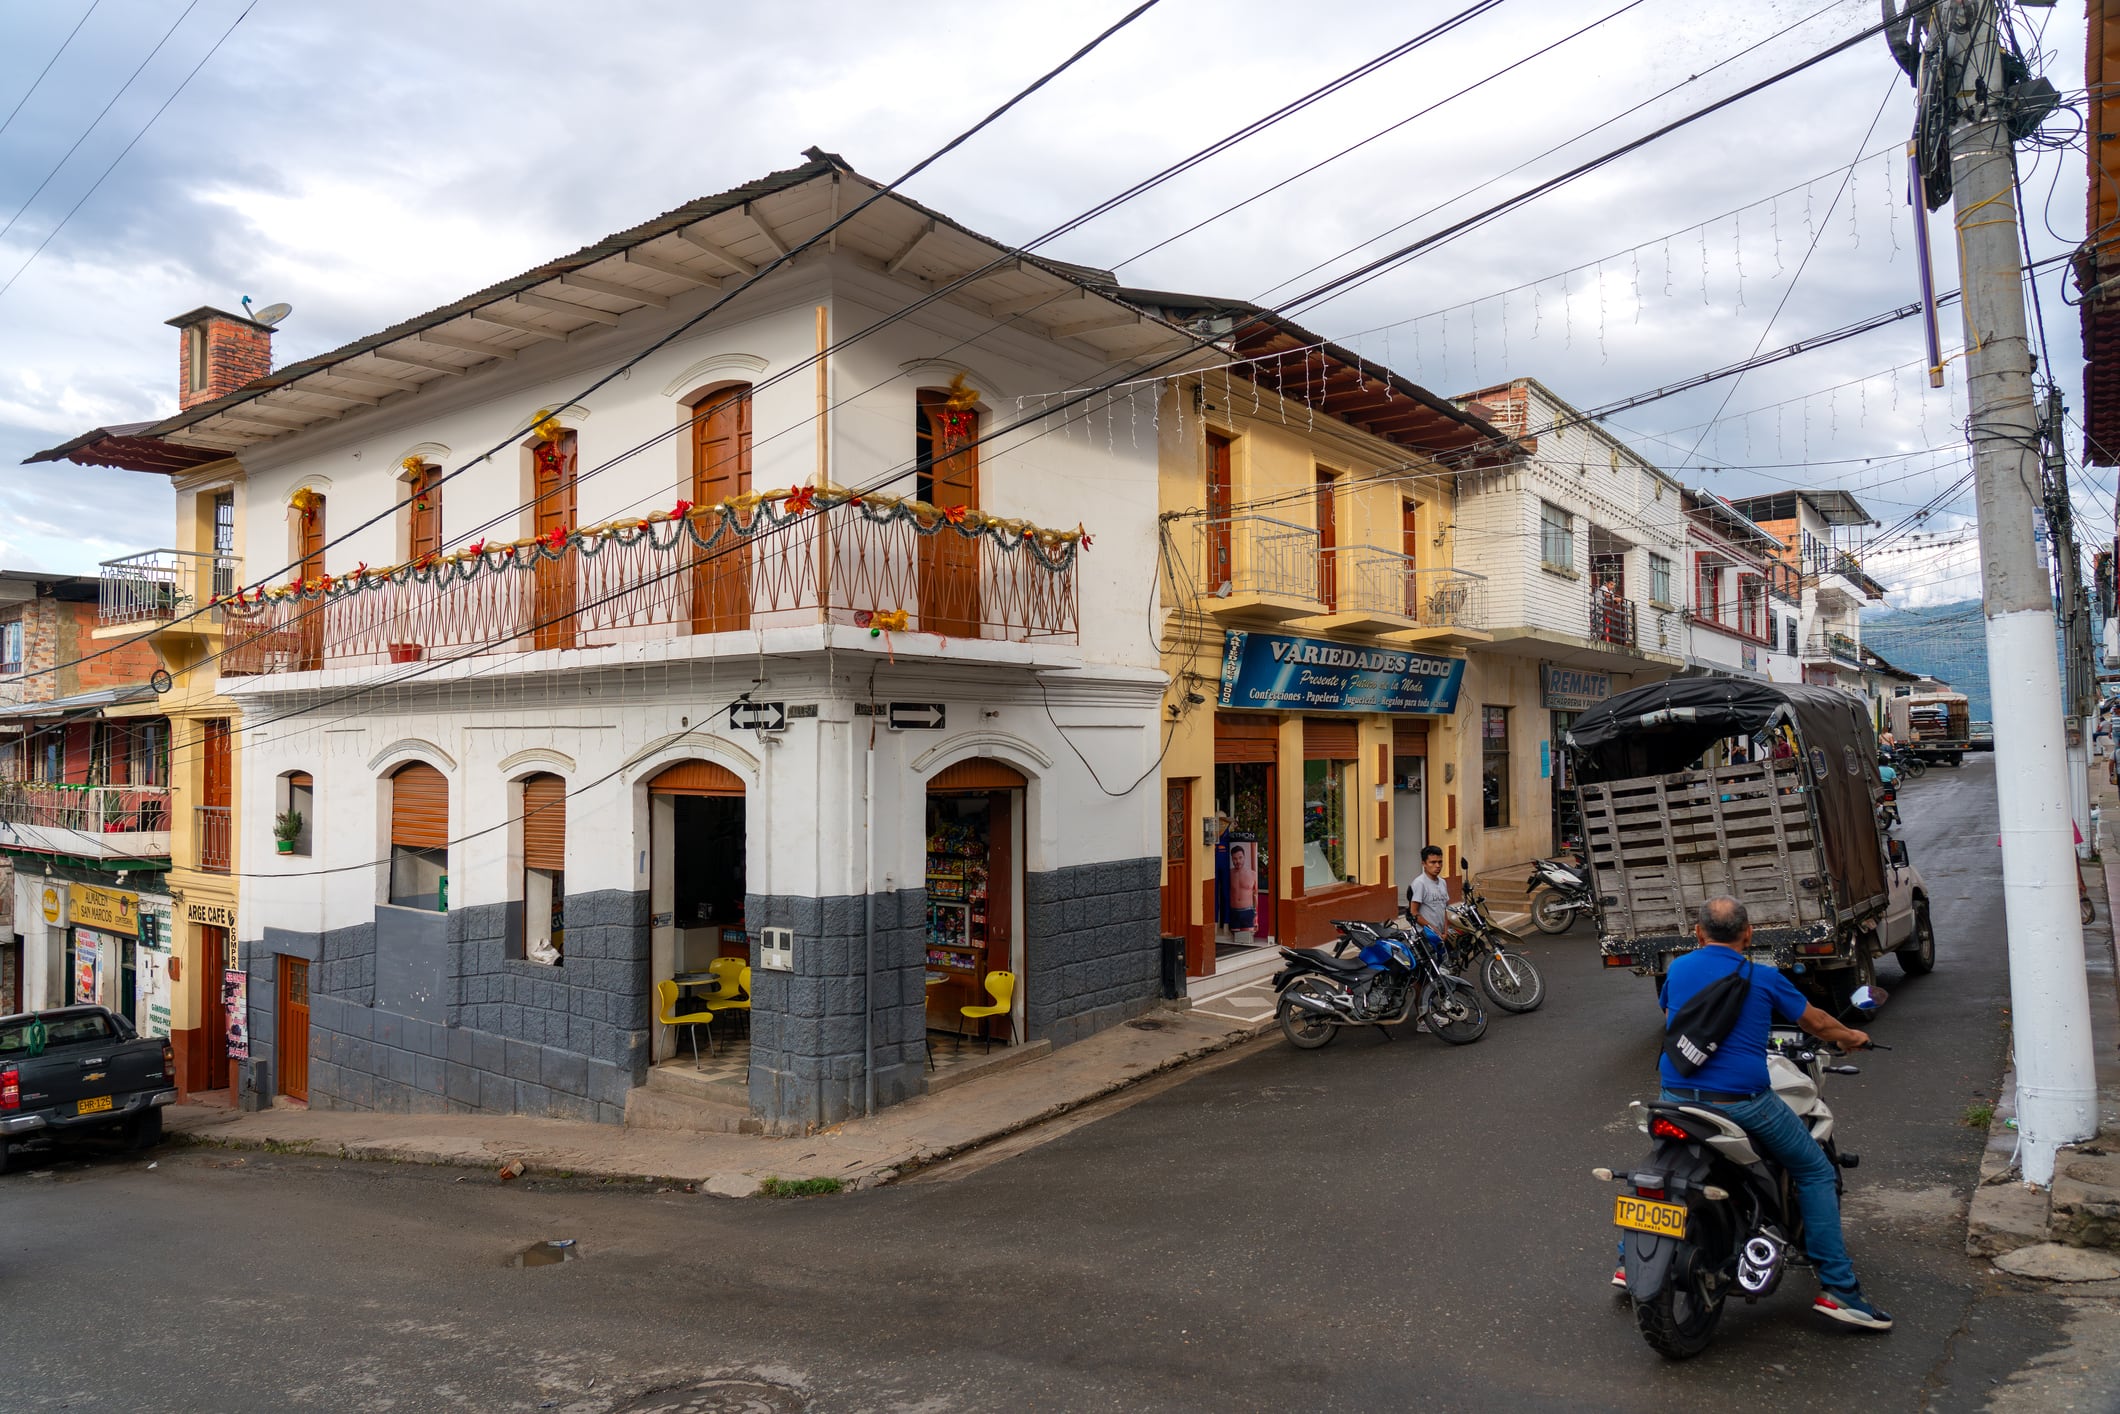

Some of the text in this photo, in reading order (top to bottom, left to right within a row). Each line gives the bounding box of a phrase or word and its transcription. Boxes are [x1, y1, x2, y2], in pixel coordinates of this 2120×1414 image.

[1226, 630, 1246, 680] VARIEDADES
[1271, 641, 1451, 677] VARIEDADES 2000
[1300, 670, 1338, 686] Presente
[1341, 678, 1347, 690] y
[1349, 674, 1377, 690] Futuro
[1391, 679, 1399, 691] la
[1401, 678, 1423, 693] Moda
[1551, 670, 1606, 696] REMATE
[1249, 688, 1301, 702] Confecciones
[1381, 696, 1403, 708] Regalos
[1404, 699, 1417, 708] para
[81, 905, 112, 923] SAN MARCOS
[188, 904, 206, 921] ARGE
[1677, 1034, 1708, 1066] PUMA
